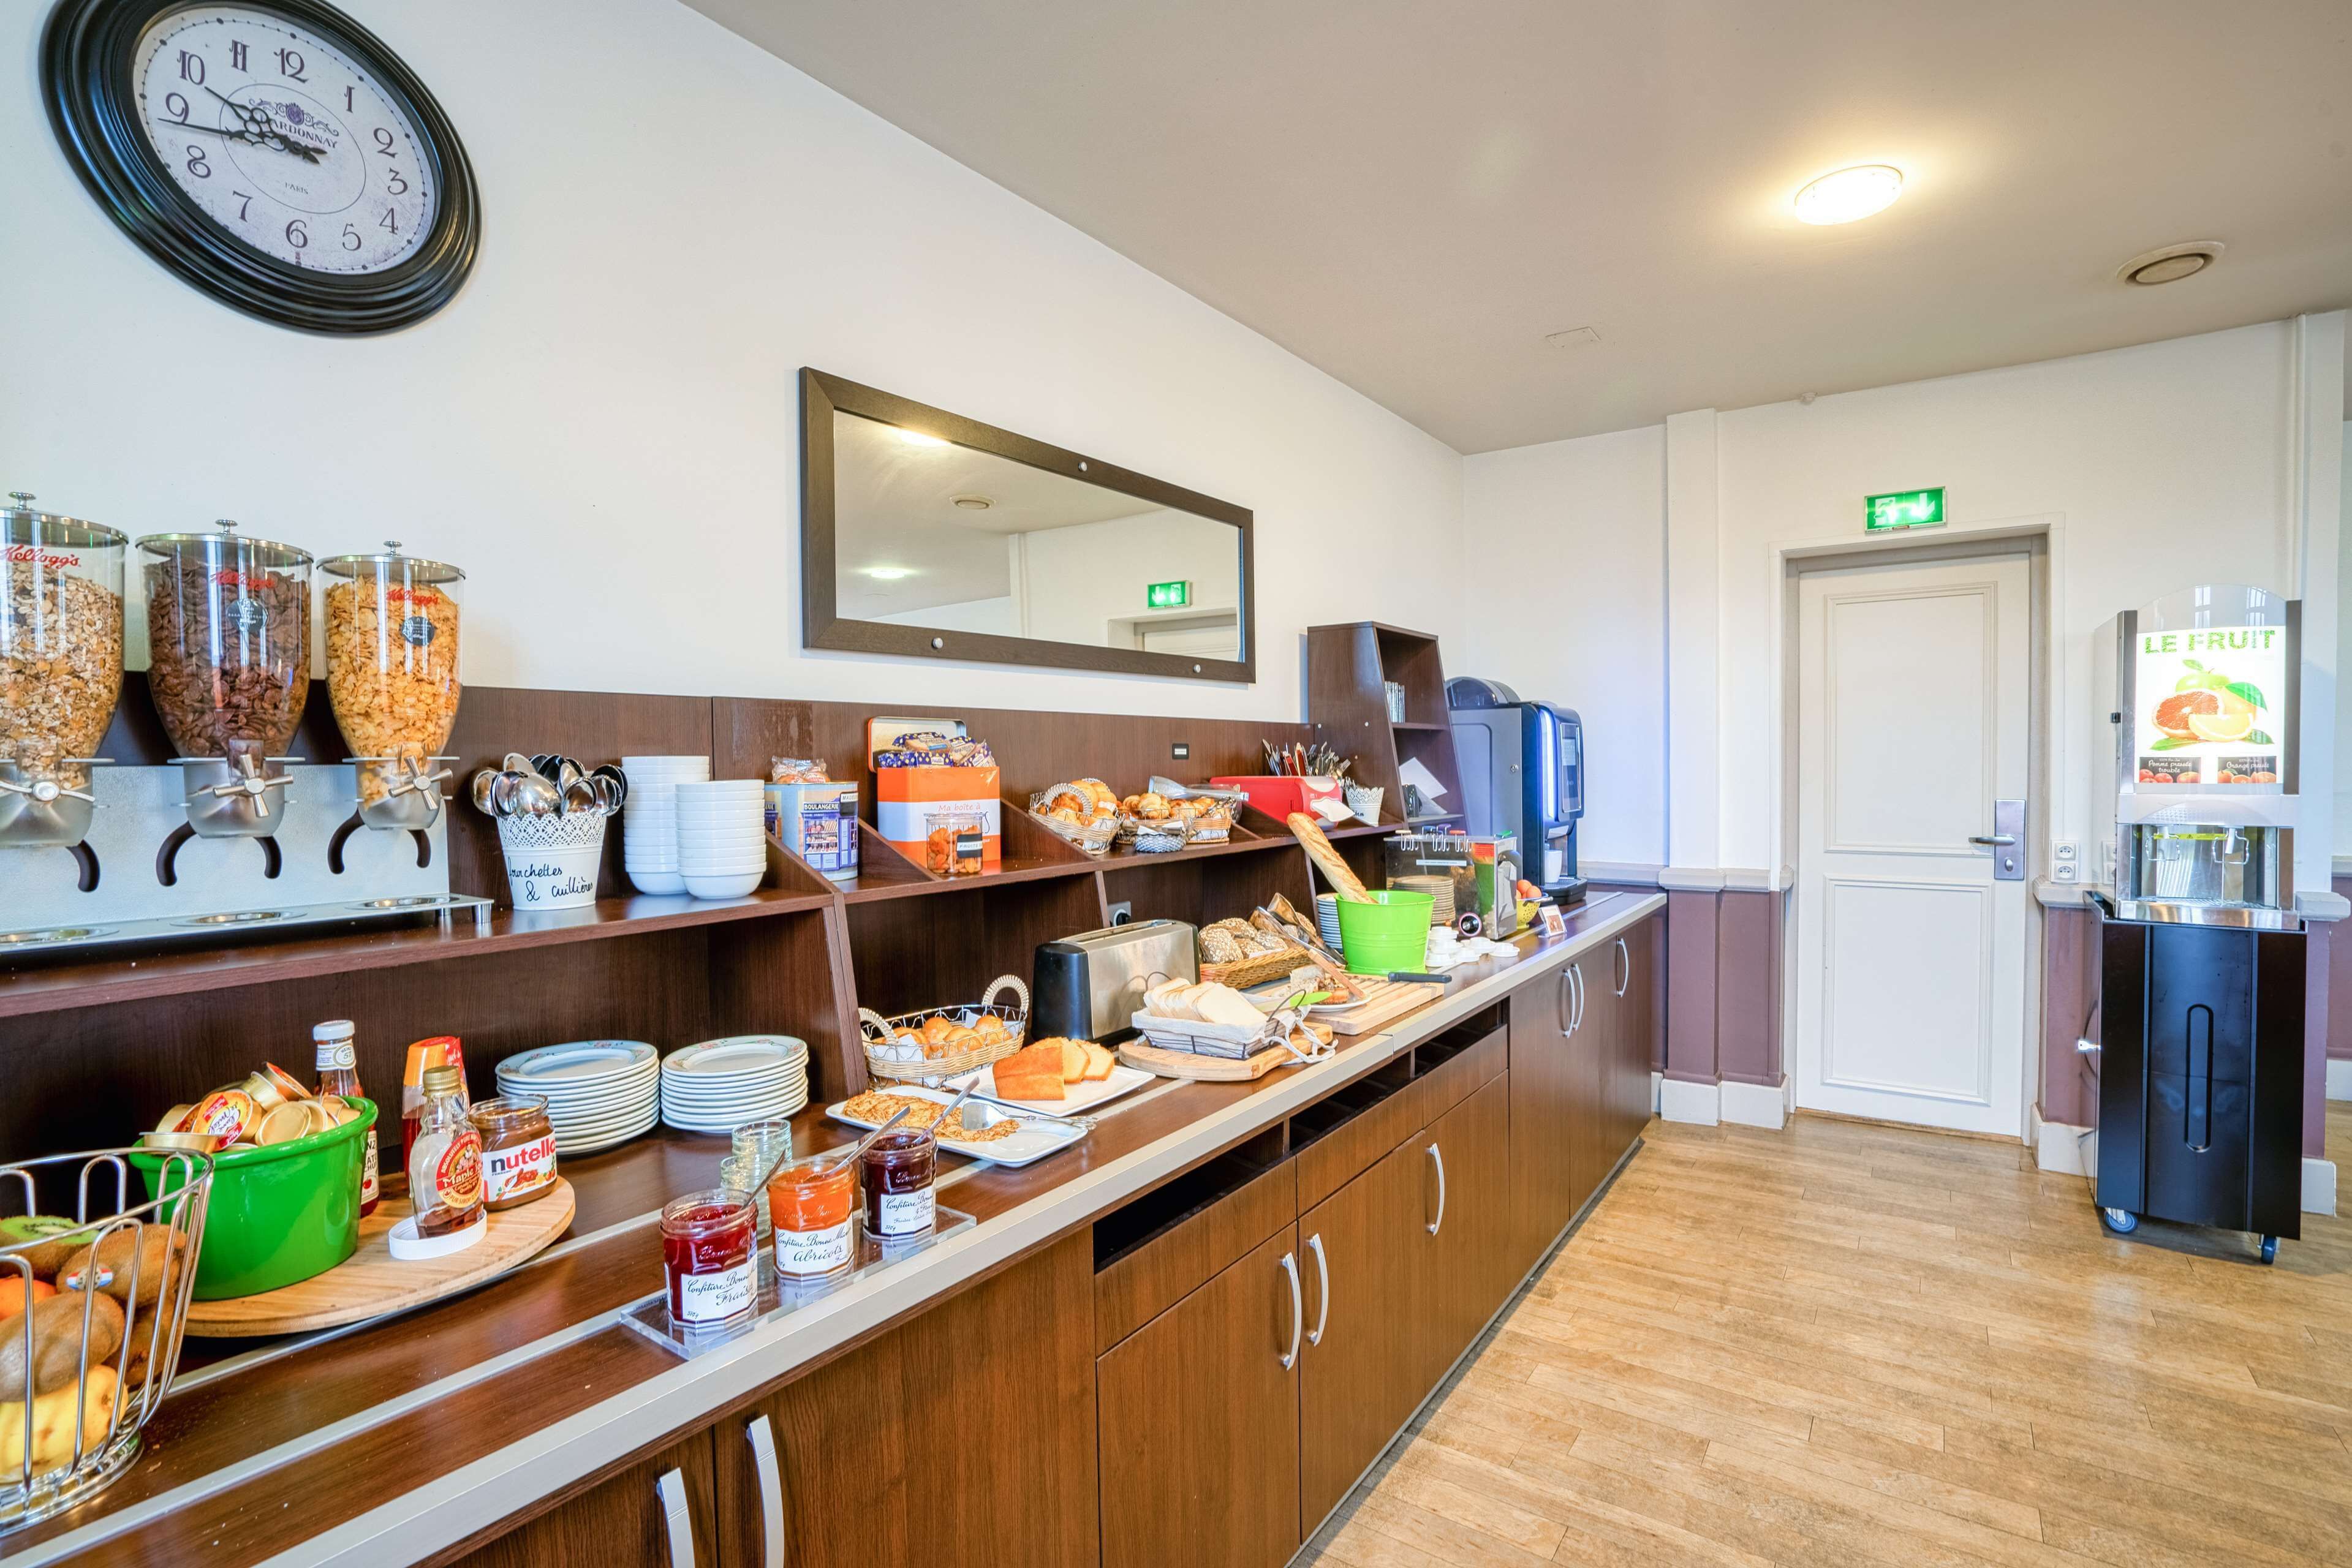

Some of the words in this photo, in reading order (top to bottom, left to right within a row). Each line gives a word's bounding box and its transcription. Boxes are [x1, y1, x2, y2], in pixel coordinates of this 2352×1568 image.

[177, 50, 206, 86] 10
[229, 39, 251, 73] 11
[273, 48, 309, 83] 12
[165, 92, 189, 123] 9
[344, 85, 355, 114] 1
[274, 121, 338, 149] ARDONNAY
[373, 127, 399, 159] 2
[186, 145, 211, 179] 8
[285, 182, 309, 195] PARIS
[388, 167, 409, 195] 3
[232, 190, 253, 222] 7
[285, 219, 308, 248] 6
[379, 207, 398, 235] 4
[342, 223, 362, 251] 5
[2146, 635, 2177, 654] LE
[2188, 630, 2275, 651] FRUIT
[2226, 761, 2250, 771] Orange
[955, 802, 973, 811] boîte
[526, 880, 540, 902] &
[442, 1167, 474, 1188] Maple
[887, 1197, 917, 1212] Confiture
[777, 1232, 806, 1248] Confiture
[806, 1233, 833, 1247] Bonne
[687, 1279, 725, 1296] Confiture
